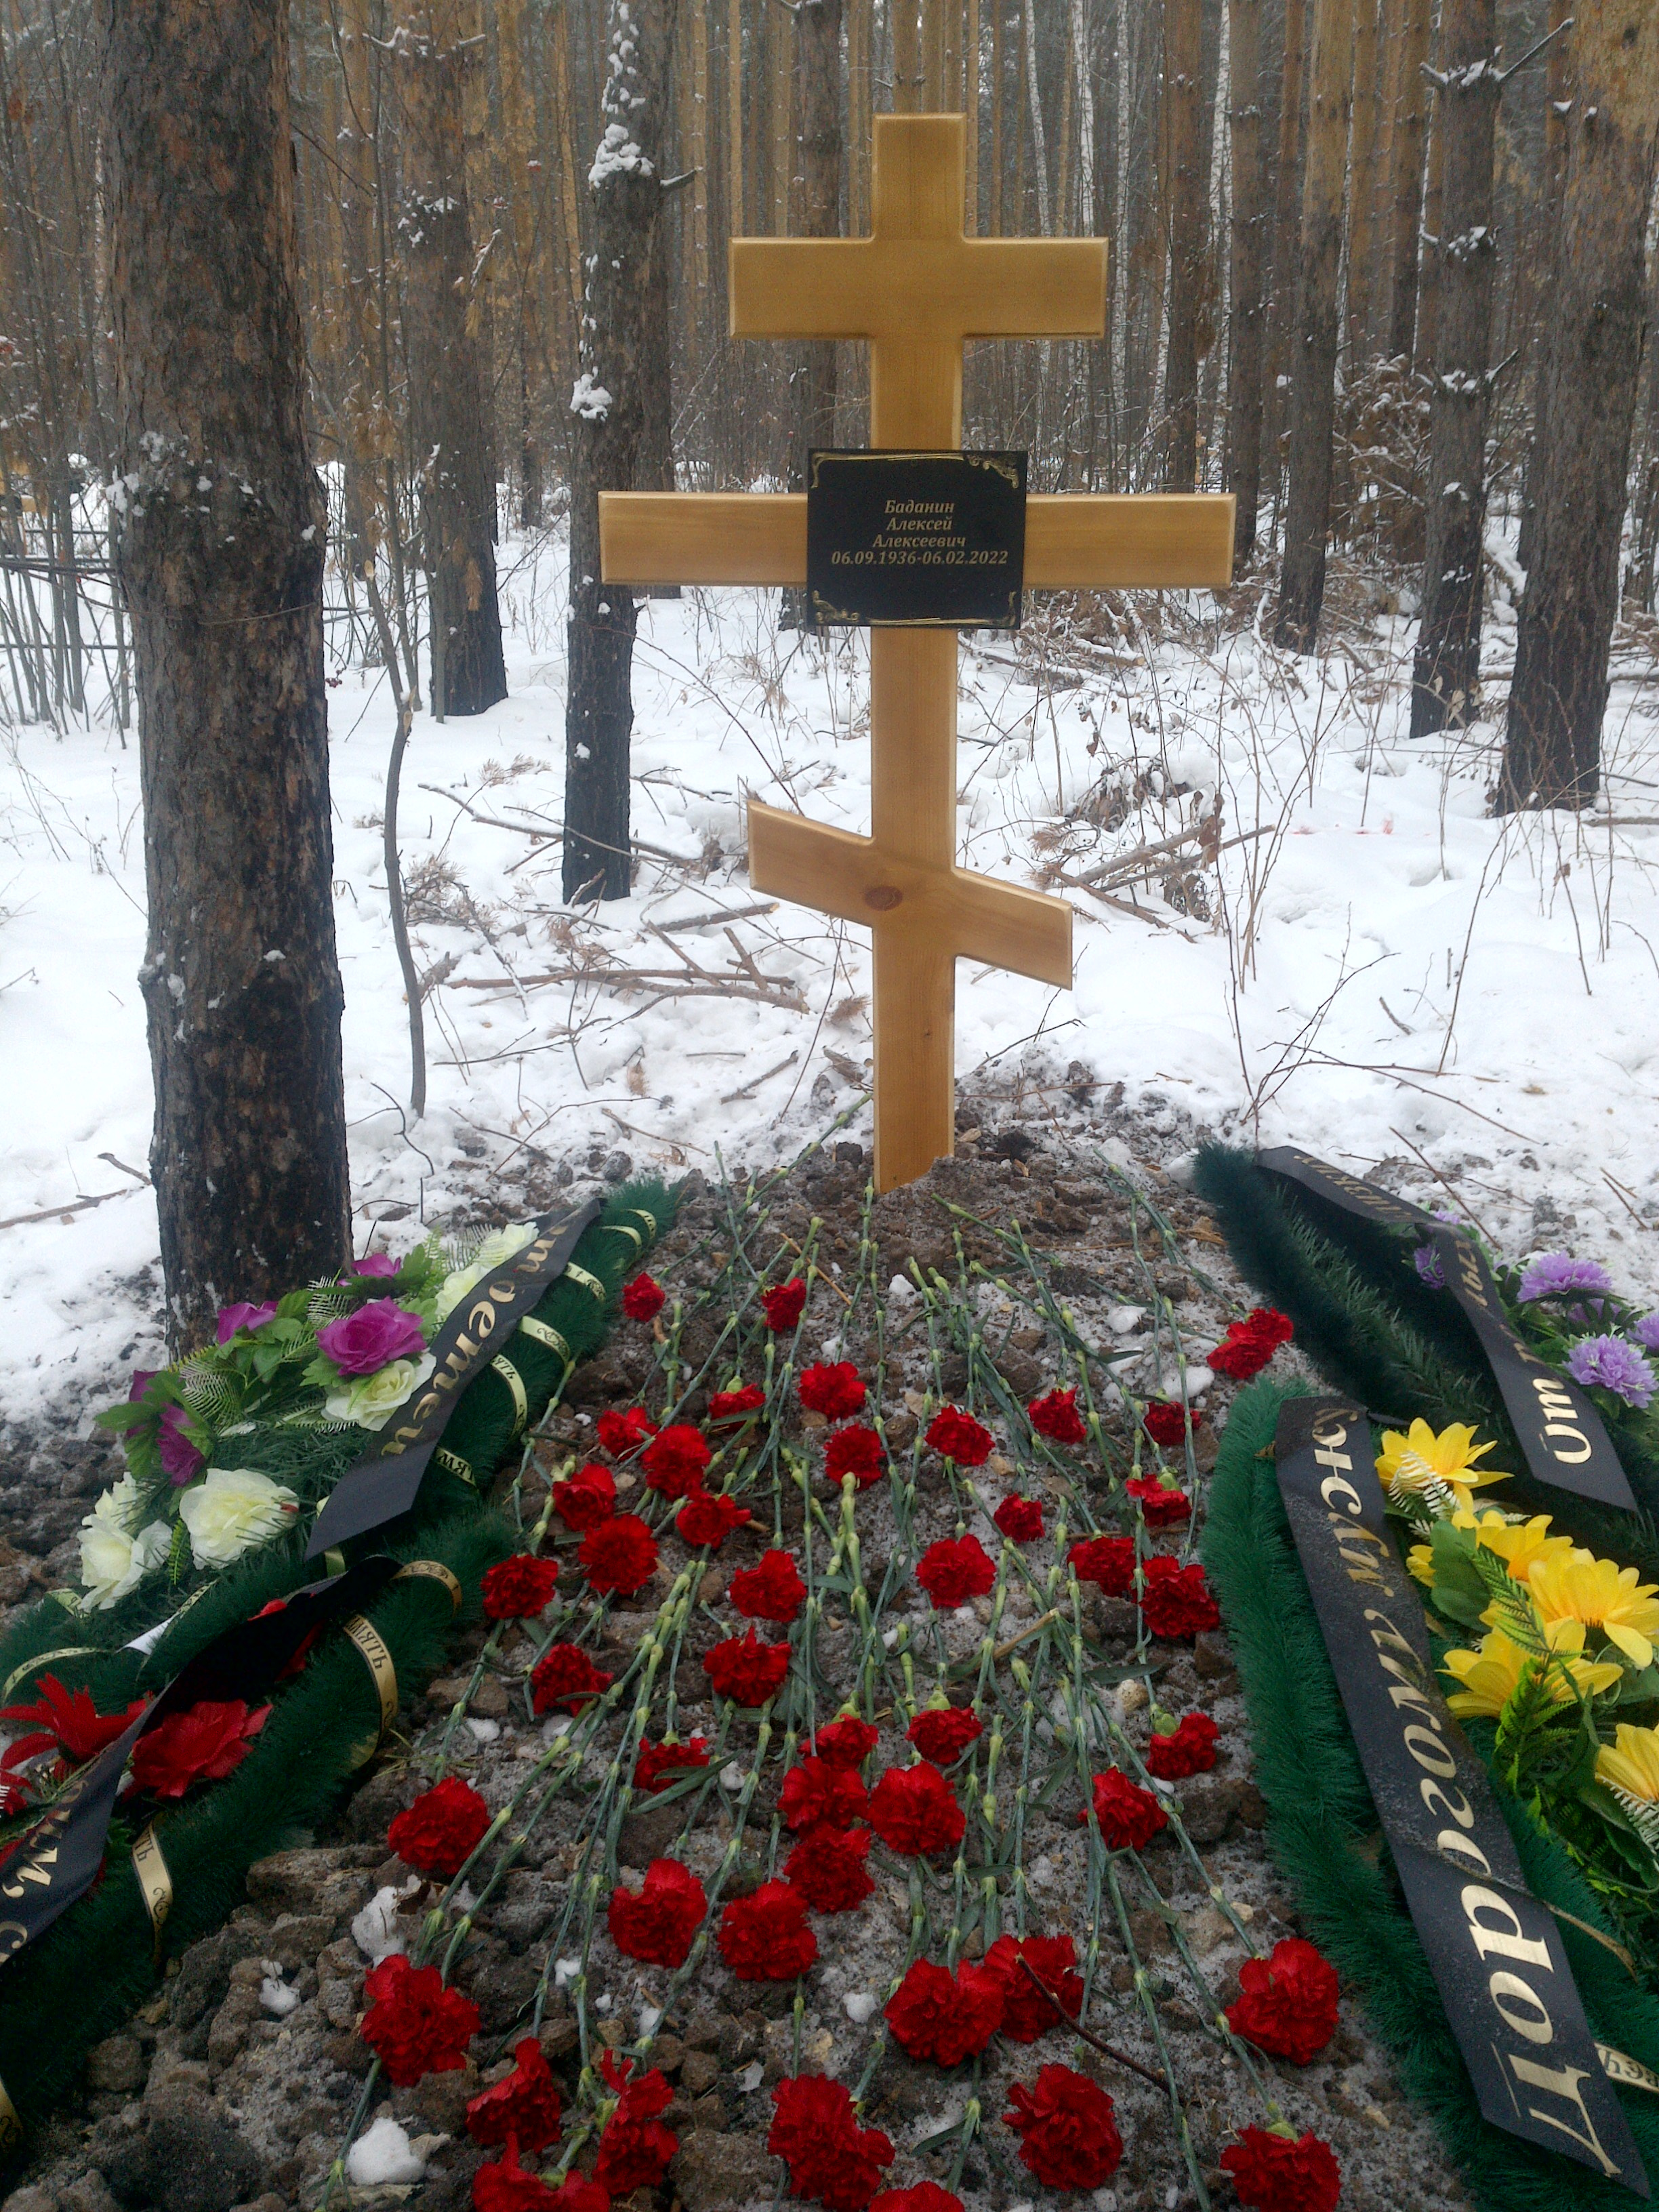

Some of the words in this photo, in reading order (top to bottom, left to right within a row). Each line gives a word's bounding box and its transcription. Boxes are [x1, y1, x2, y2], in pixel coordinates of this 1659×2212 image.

[884, 499, 954, 514] Баданин
[886, 516, 953, 531] Алексей
[872, 534, 966, 548] Алексеевич
[831, 550, 1008, 565] 06.09.1936-06.02.2022
[1364, 1608, 1622, 2177] Дорогому
